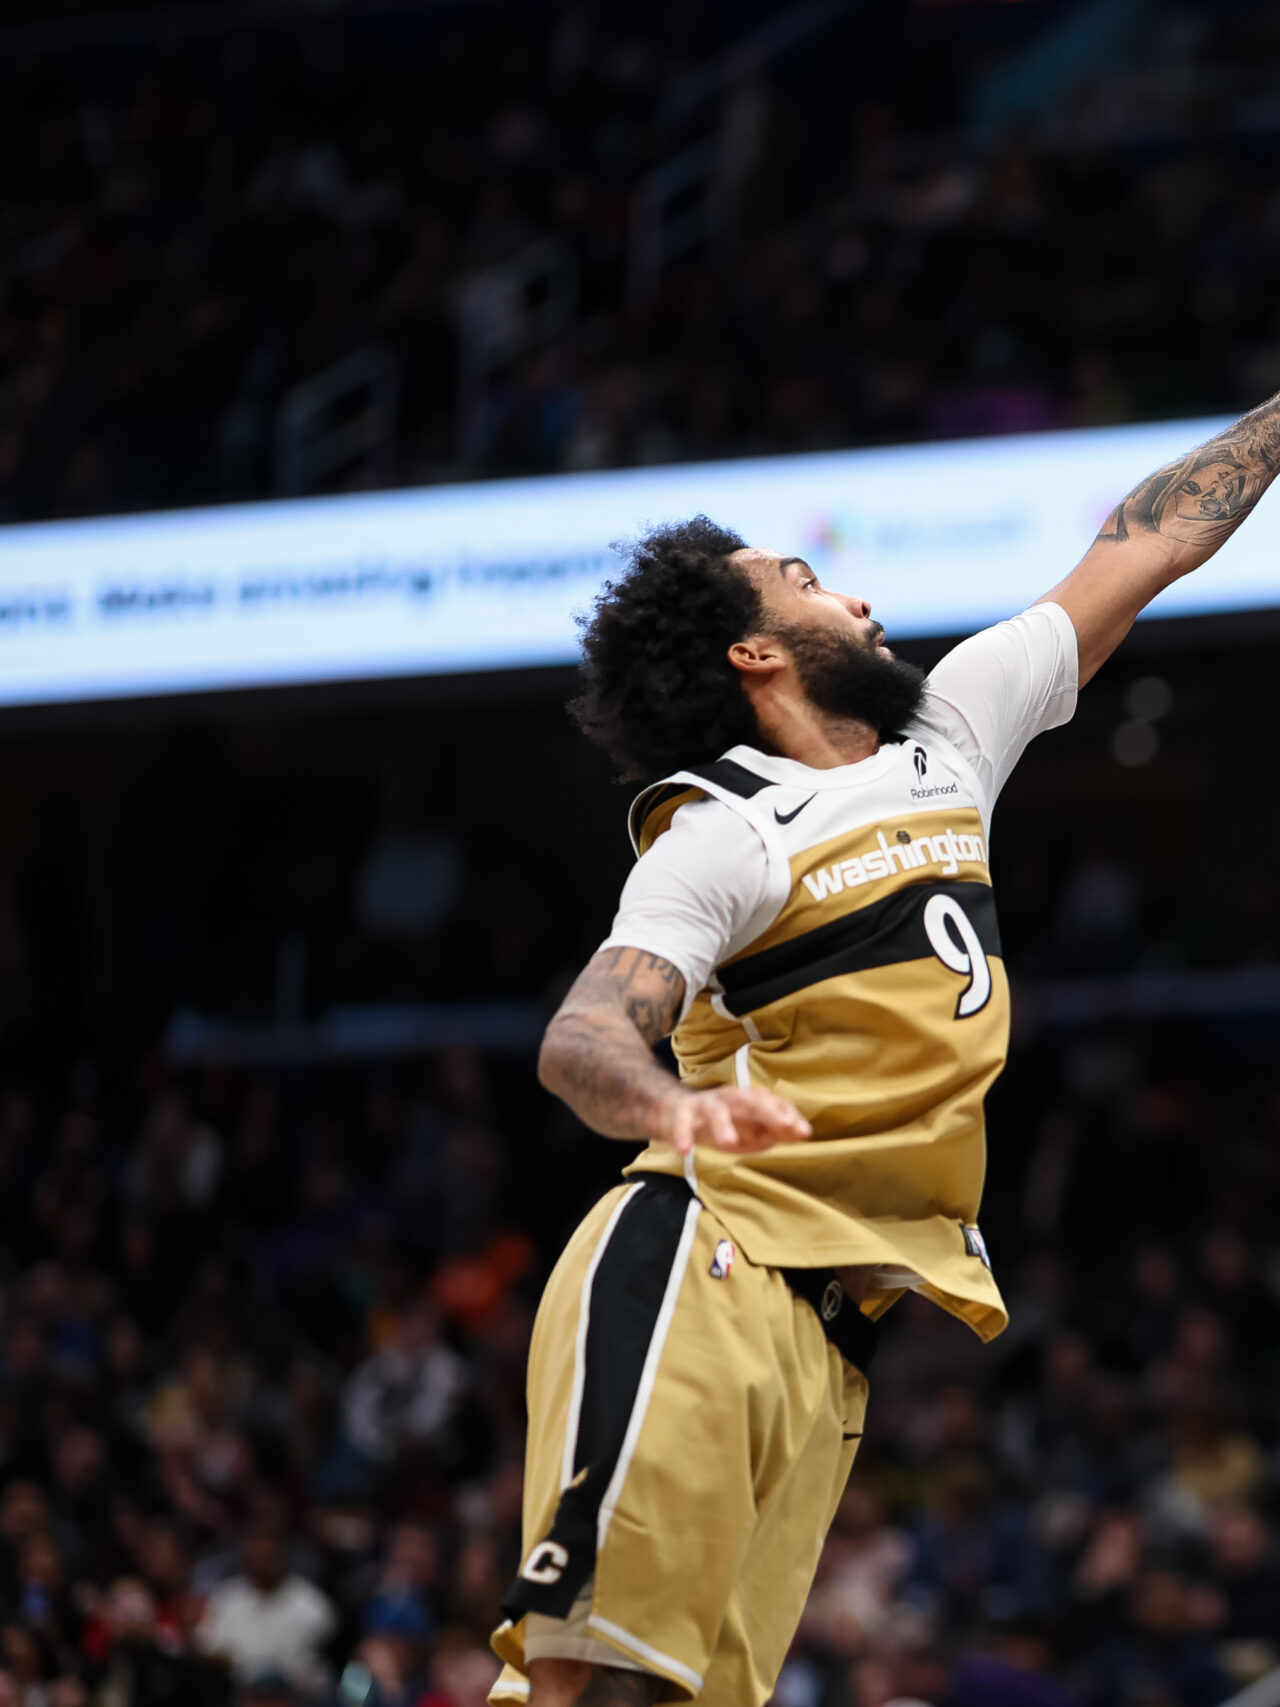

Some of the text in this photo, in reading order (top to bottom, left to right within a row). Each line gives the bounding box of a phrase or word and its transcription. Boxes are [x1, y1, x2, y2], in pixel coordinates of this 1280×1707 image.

[910, 781, 959, 800] Robinhood
[801, 829, 987, 902] washington
[924, 893, 991, 1020] 9
[522, 1539, 569, 1586] C
